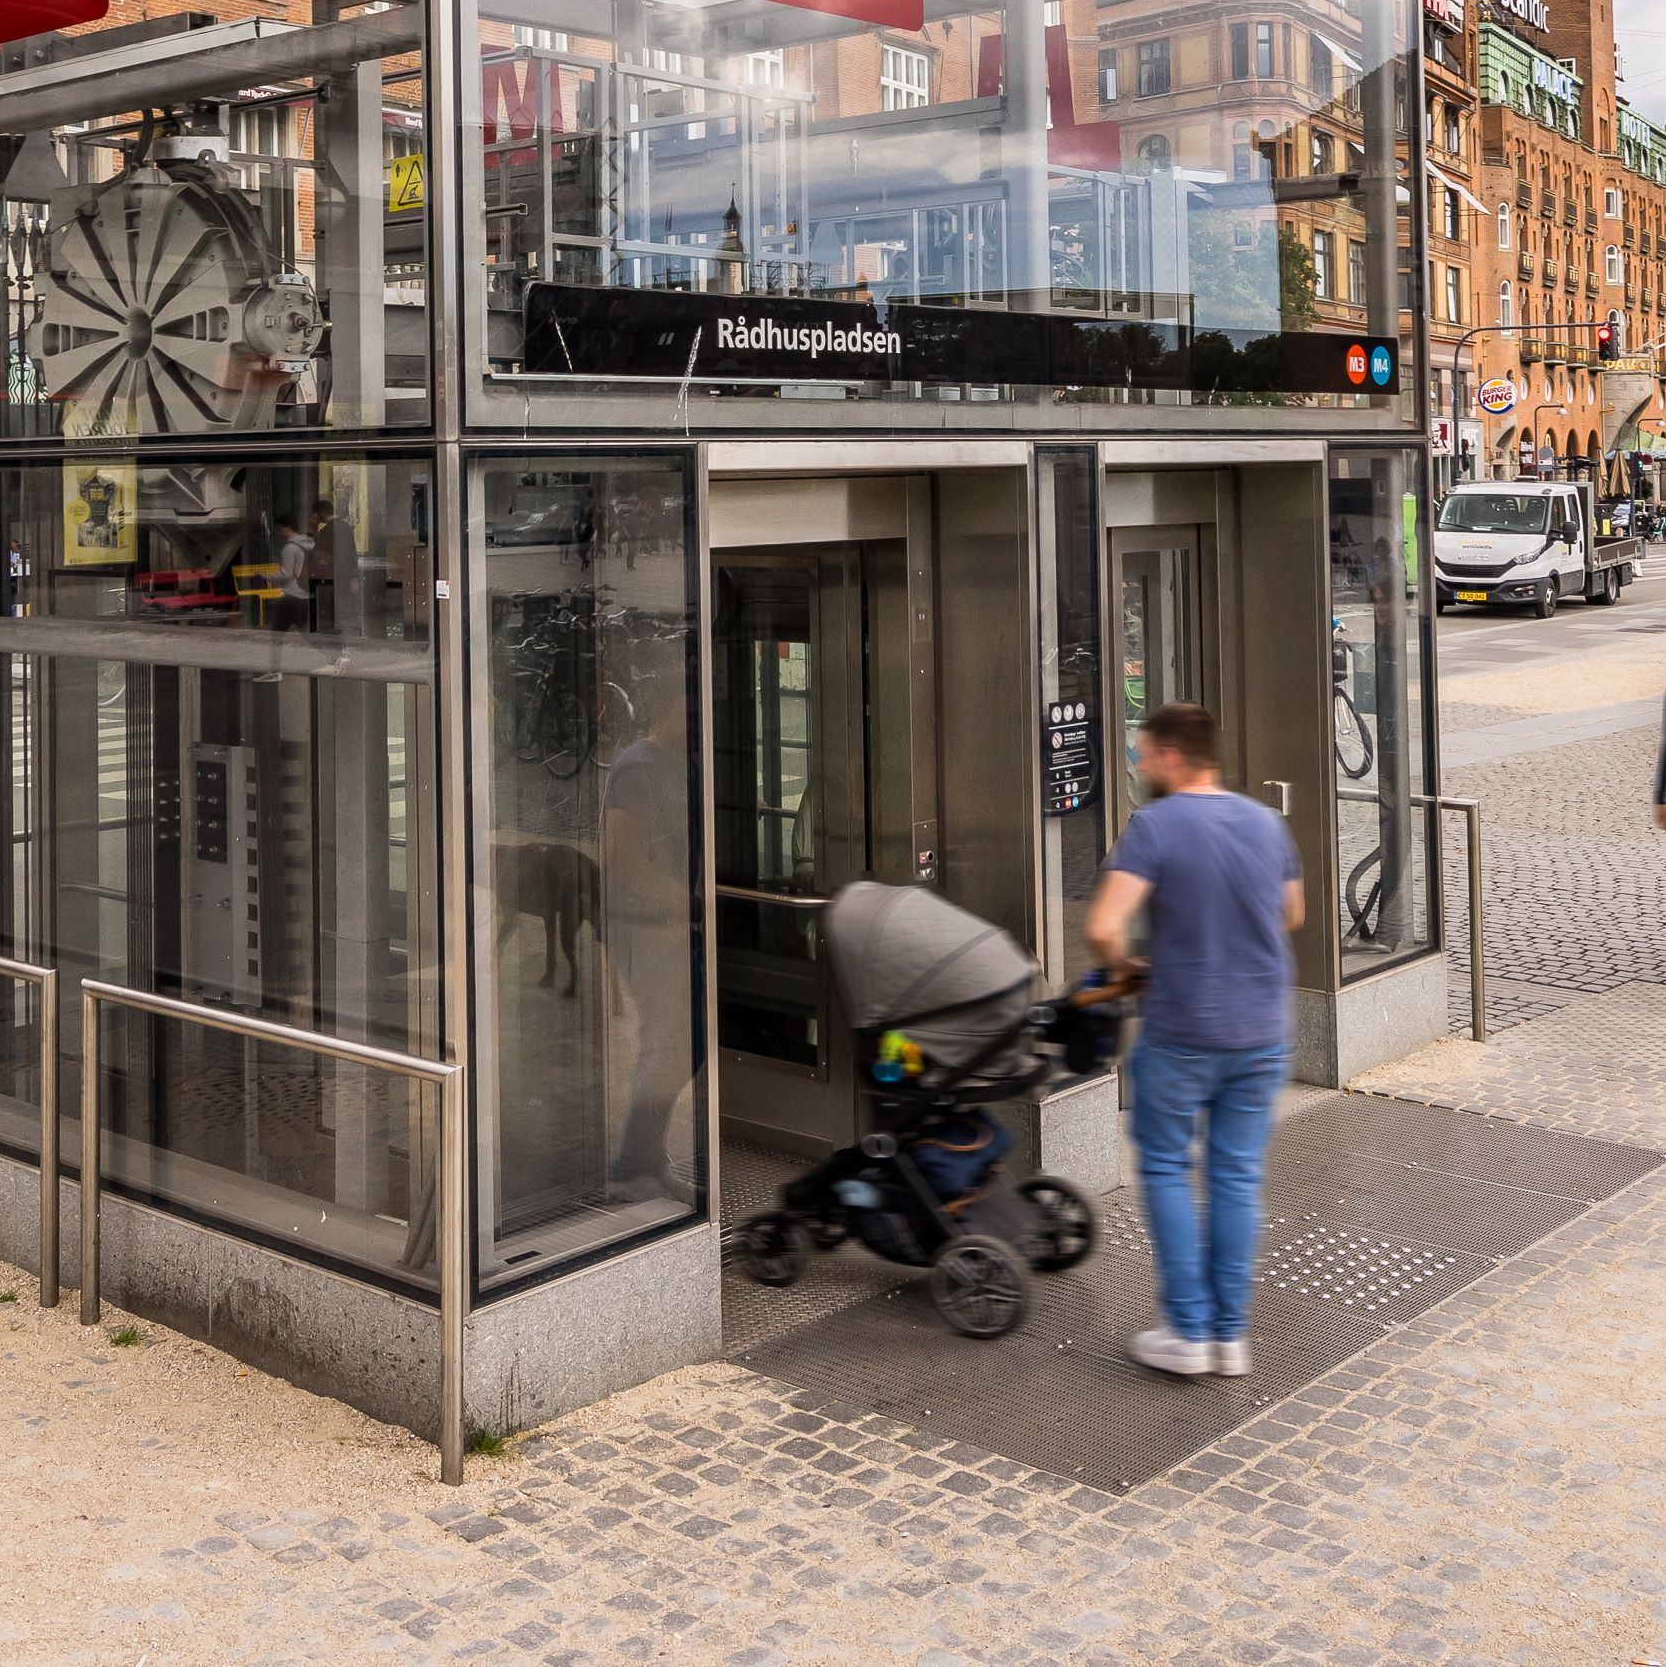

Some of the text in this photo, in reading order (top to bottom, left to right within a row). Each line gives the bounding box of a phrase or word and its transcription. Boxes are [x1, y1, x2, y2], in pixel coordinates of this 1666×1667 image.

[1620, 110, 1652, 150] HOTEL
[717, 315, 901, 359] Rådhuspladsen
[1349, 356, 1389, 374] M3 M4
[1481, 385, 1513, 397] BURGER
[1482, 392, 1513, 406] KING
